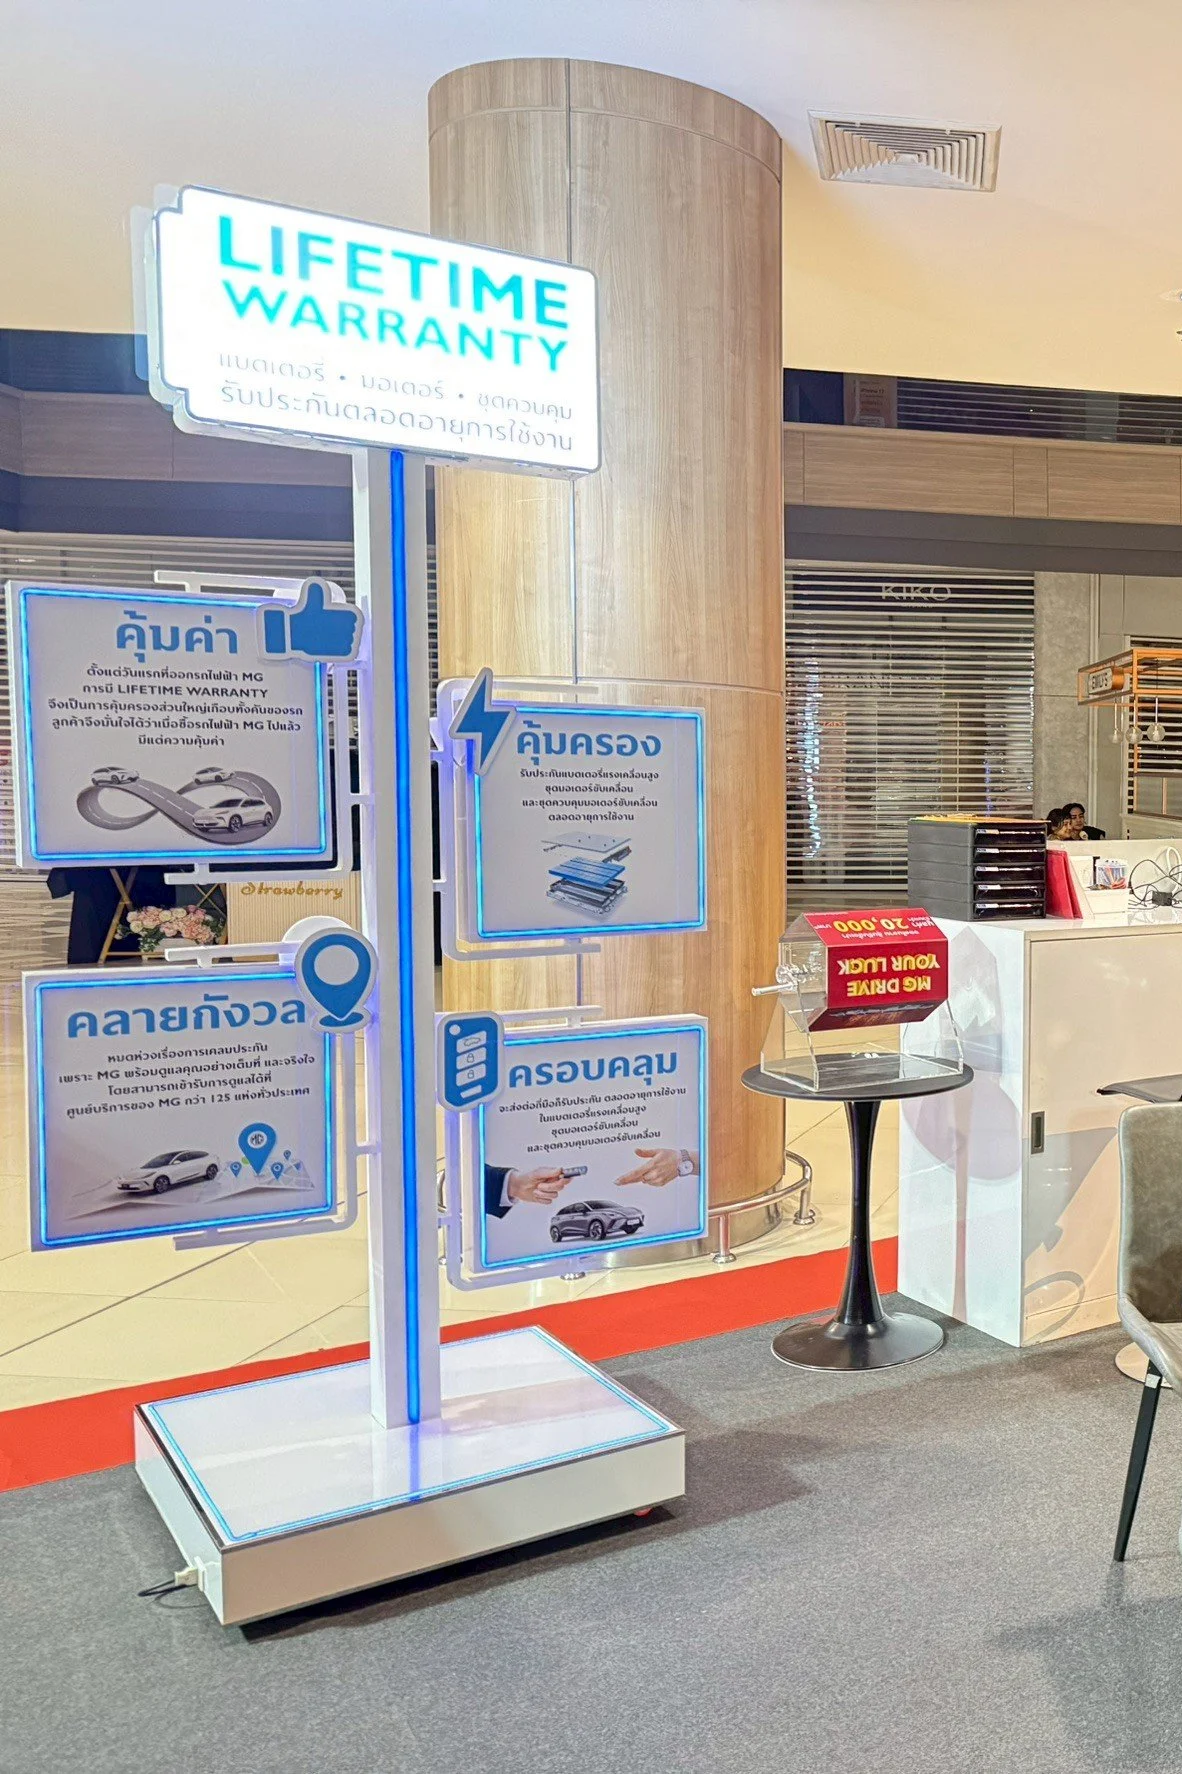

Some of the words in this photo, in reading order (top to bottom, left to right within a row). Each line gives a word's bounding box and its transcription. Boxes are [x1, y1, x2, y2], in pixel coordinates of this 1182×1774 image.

[219, 214, 568, 329] LIFETIME
[221, 279, 568, 373] WARRANTY
[361, 373, 445, 401] มอเตอร์
[478, 392, 573, 421] ชุดควบคุม
[220, 379, 573, 452] รับประกันตลอดอายุการใช้งาน
[881, 583, 952, 602] KIKO
[116, 610, 238, 663] คุ้มค่า
[87, 663, 238, 681] ตั้งแต่วันแรกที่ออกรถไฟฟ้า
[242, 672, 264, 682] MG
[83, 683, 113, 694] การมี
[118, 685, 182, 696] LIFETIME
[186, 687, 268, 698] WARRANTY
[243, 721, 264, 731] MG
[267, 719, 301, 732] ไปแล้ว
[138, 734, 225, 749] มีแต่ความคุ้มค่า
[516, 720, 662, 766] คุ้มครอง
[519, 768, 659, 782] รับประกันแบตเตอรี่แรงเคลื่อนสูง
[545, 782, 634, 795] ชุดมอเตอร์ขับเคลื่อน
[522, 796, 658, 809] และชุดควบคุมมอเตอร์ขับเคลื่อน
[548, 811, 635, 823] ตลอดอายุการใช้งาน
[240, 881, 344, 900] Strawberry
[834, 917, 909, 933] 20,000
[837, 957, 887, 976] LUCK
[891, 953, 941, 972] YOUR
[846, 977, 900, 997] DRIVE
[902, 976, 932, 992] MG
[67, 993, 307, 1038] คลายกังวล
[107, 1042, 268, 1063] หมดห่วงเรื่องการเคลมประกัน
[59, 1073, 93, 1084] เพราะ
[97, 1069, 120, 1080] MG
[124, 1056, 261, 1078] พร้อมดูแลคุณอย่างเต็มที่
[264, 1054, 315, 1068] และจริงใจ
[508, 1051, 678, 1088] ครอบคลุม
[108, 1070, 272, 1096] โดยสามารถเข้ารับการดูแลได้ที่
[66, 1100, 155, 1119] ศูนย์บริการของ
[159, 1097, 181, 1108] MG
[184, 1095, 206, 1106] กว่า
[211, 1093, 231, 1103] 125
[234, 1086, 310, 1101] แห่งทั่วประเทศ
[604, 1087, 687, 1103] ตลอดอายุการใช้งาน
[551, 1118, 639, 1138] ชุดมอเตอร์ขับเคลื่อน
[526, 1128, 661, 1153] และชุดควบคุมมอเตอร์ขับเคลื่อน
